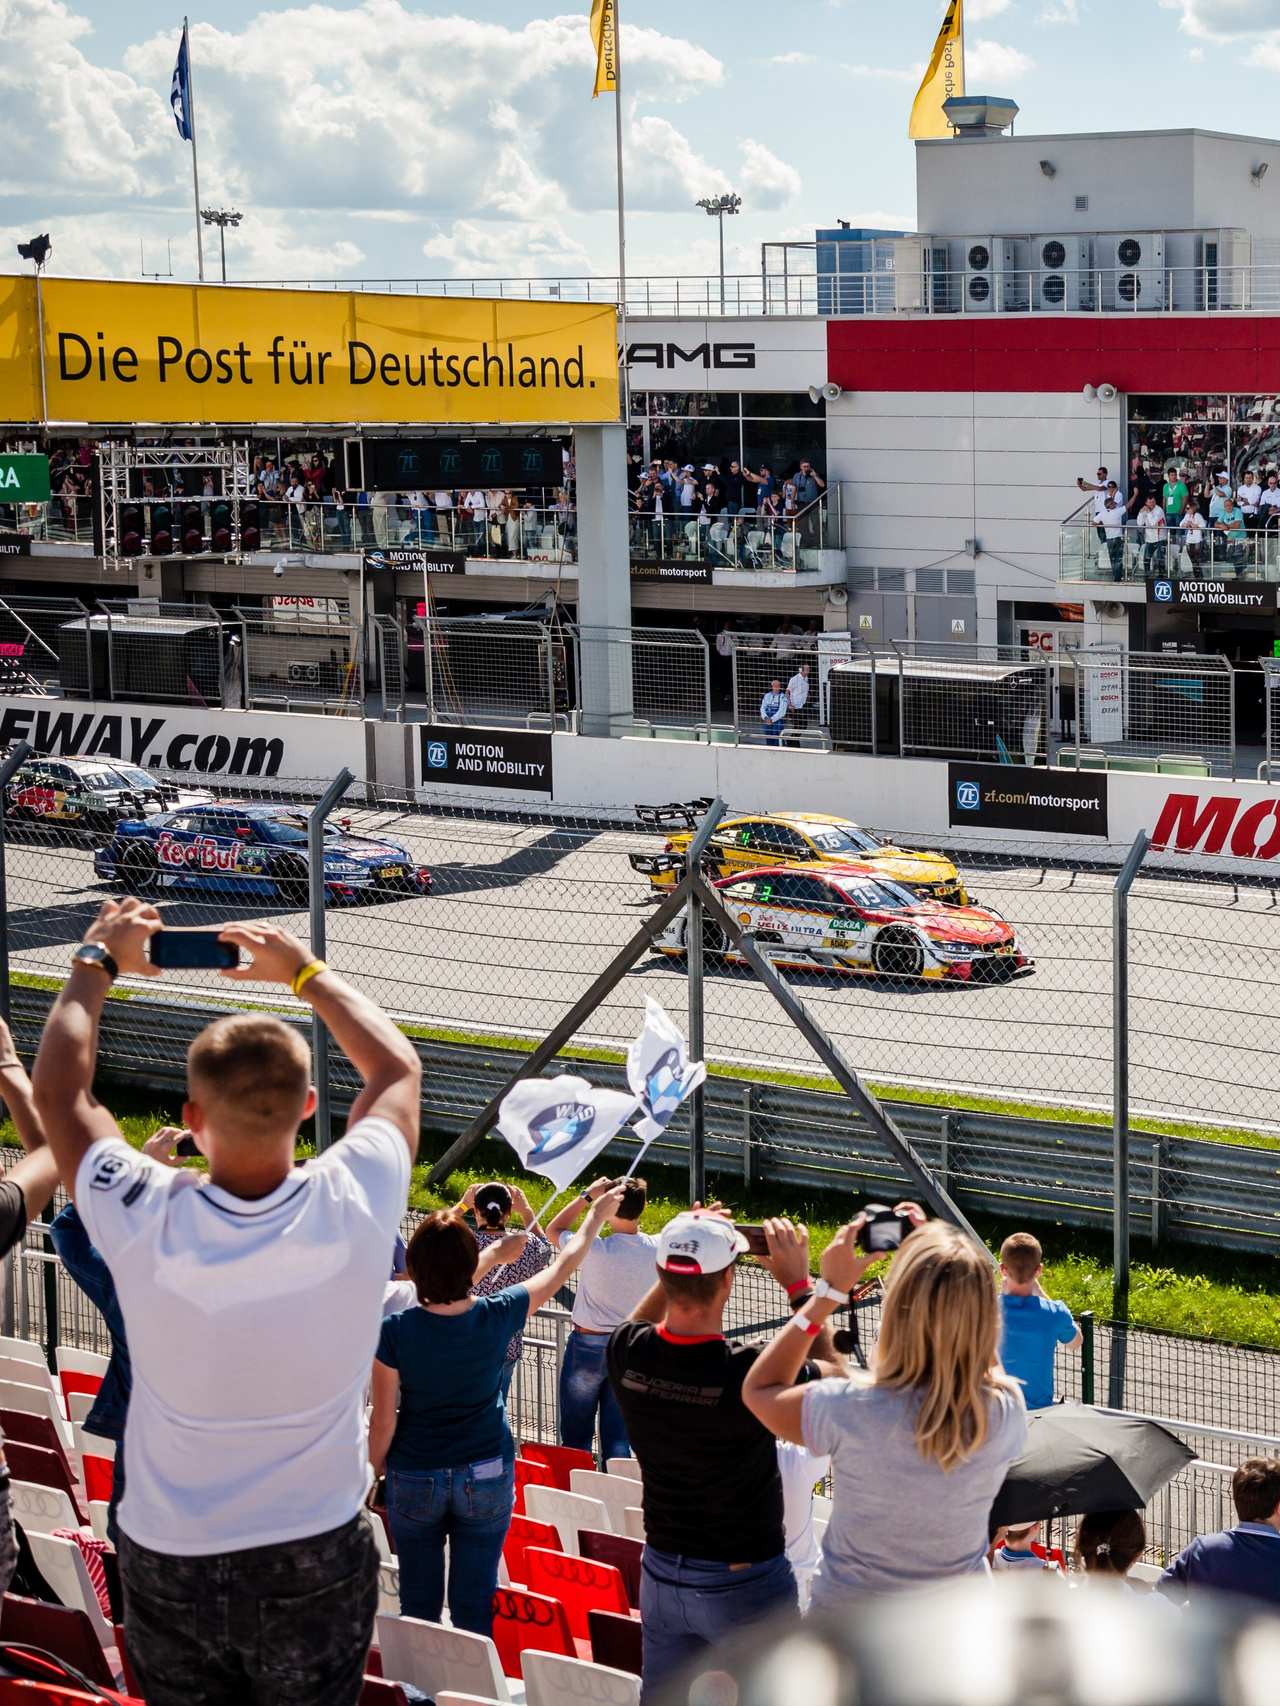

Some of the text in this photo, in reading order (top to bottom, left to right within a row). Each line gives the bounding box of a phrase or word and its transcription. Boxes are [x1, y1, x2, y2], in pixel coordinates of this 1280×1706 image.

[58, 332, 597, 390] Die Post für Deutschland.
[627, 342, 756, 369] AMG
[389, 551, 426, 561] MOTION
[1178, 581, 1225, 593] MOTION
[1180, 593, 1264, 606] AND MOBILITY
[455, 742, 504, 760] MOTION
[456, 758, 546, 777] AND MOBILITY
[984, 790, 1100, 813] zf.com/motorsport
[815, 834, 842, 849] 16
[851, 886, 882, 907] 15
[832, 919, 862, 930] DEKRA
[835, 930, 846, 939] 15
[829, 939, 850, 949] ADAC
[624, 1368, 699, 1395] SCUDERIA
[648, 1387, 720, 1407] FERRARI
